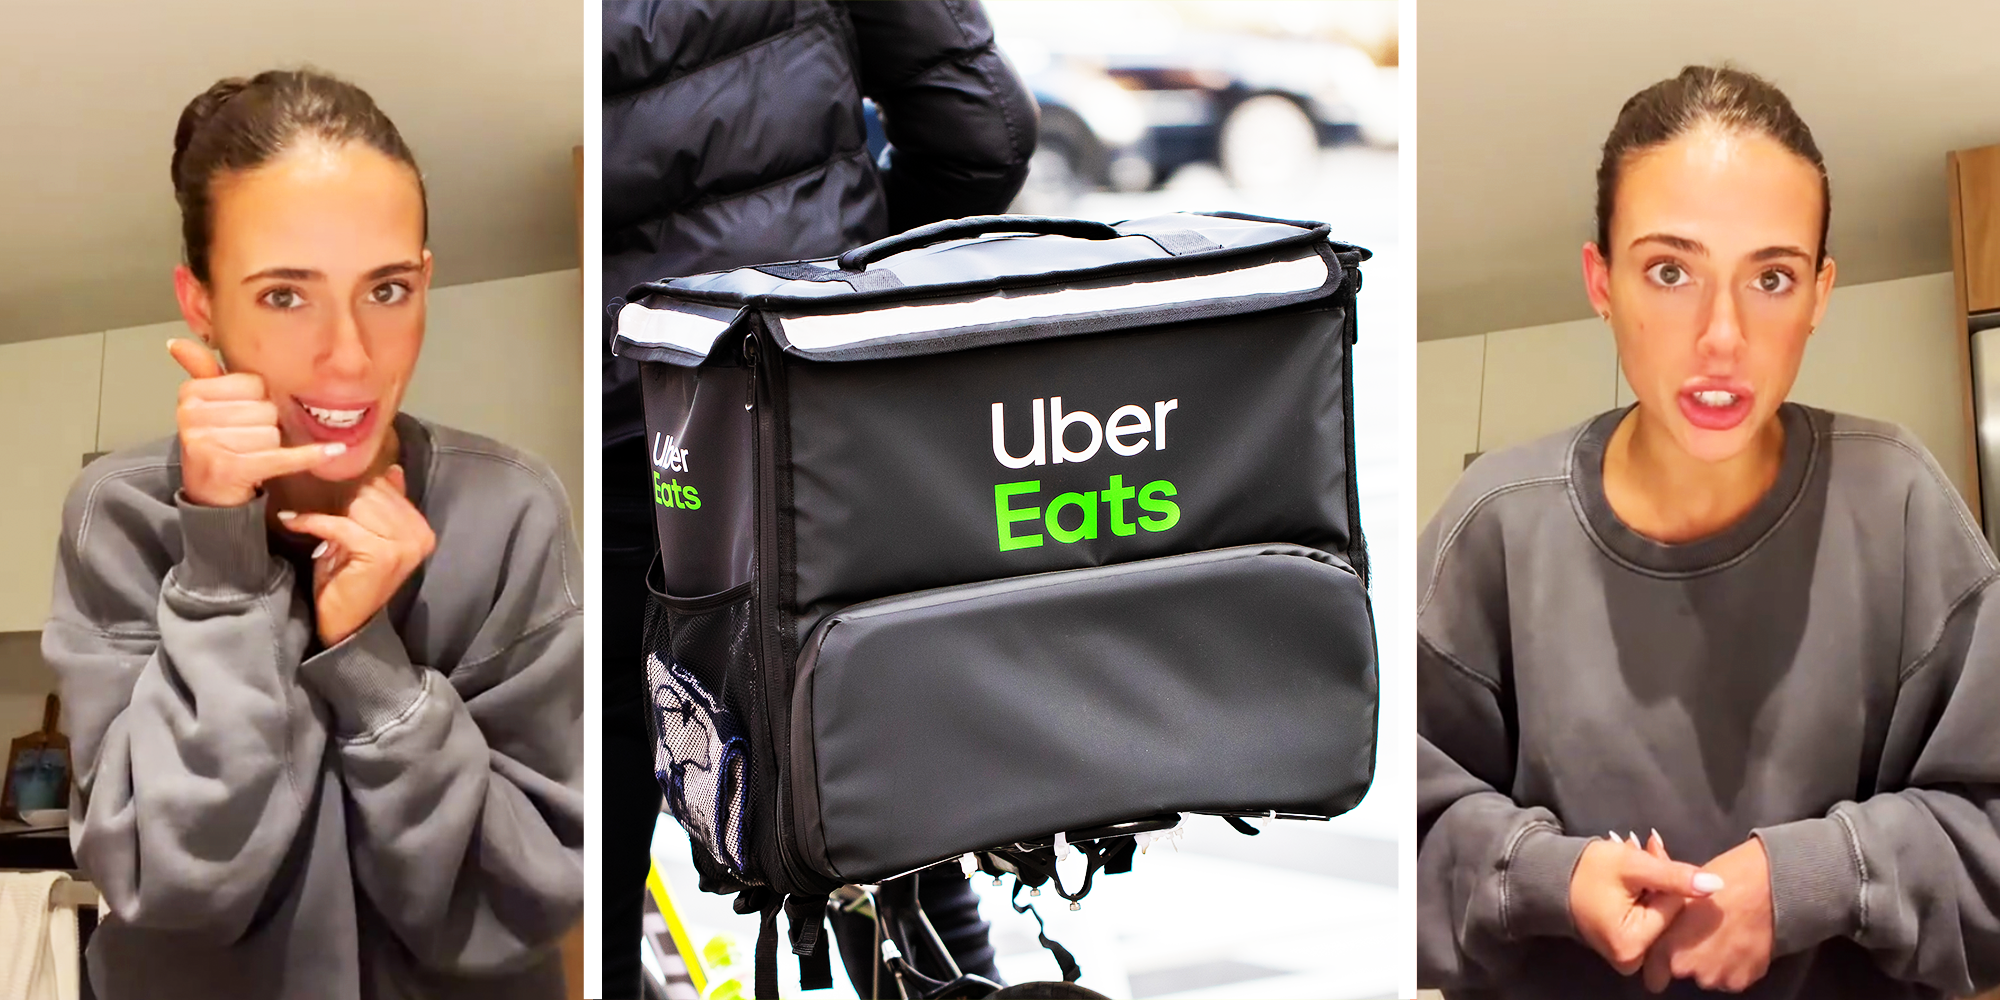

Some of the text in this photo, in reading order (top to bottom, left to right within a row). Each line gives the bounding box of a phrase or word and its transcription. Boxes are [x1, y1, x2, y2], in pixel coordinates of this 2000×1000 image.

[653, 431, 689, 473] Uber
[991, 396, 1178, 469] Uber
[653, 470, 702, 511] Eats
[994, 474, 1181, 552] Eats
